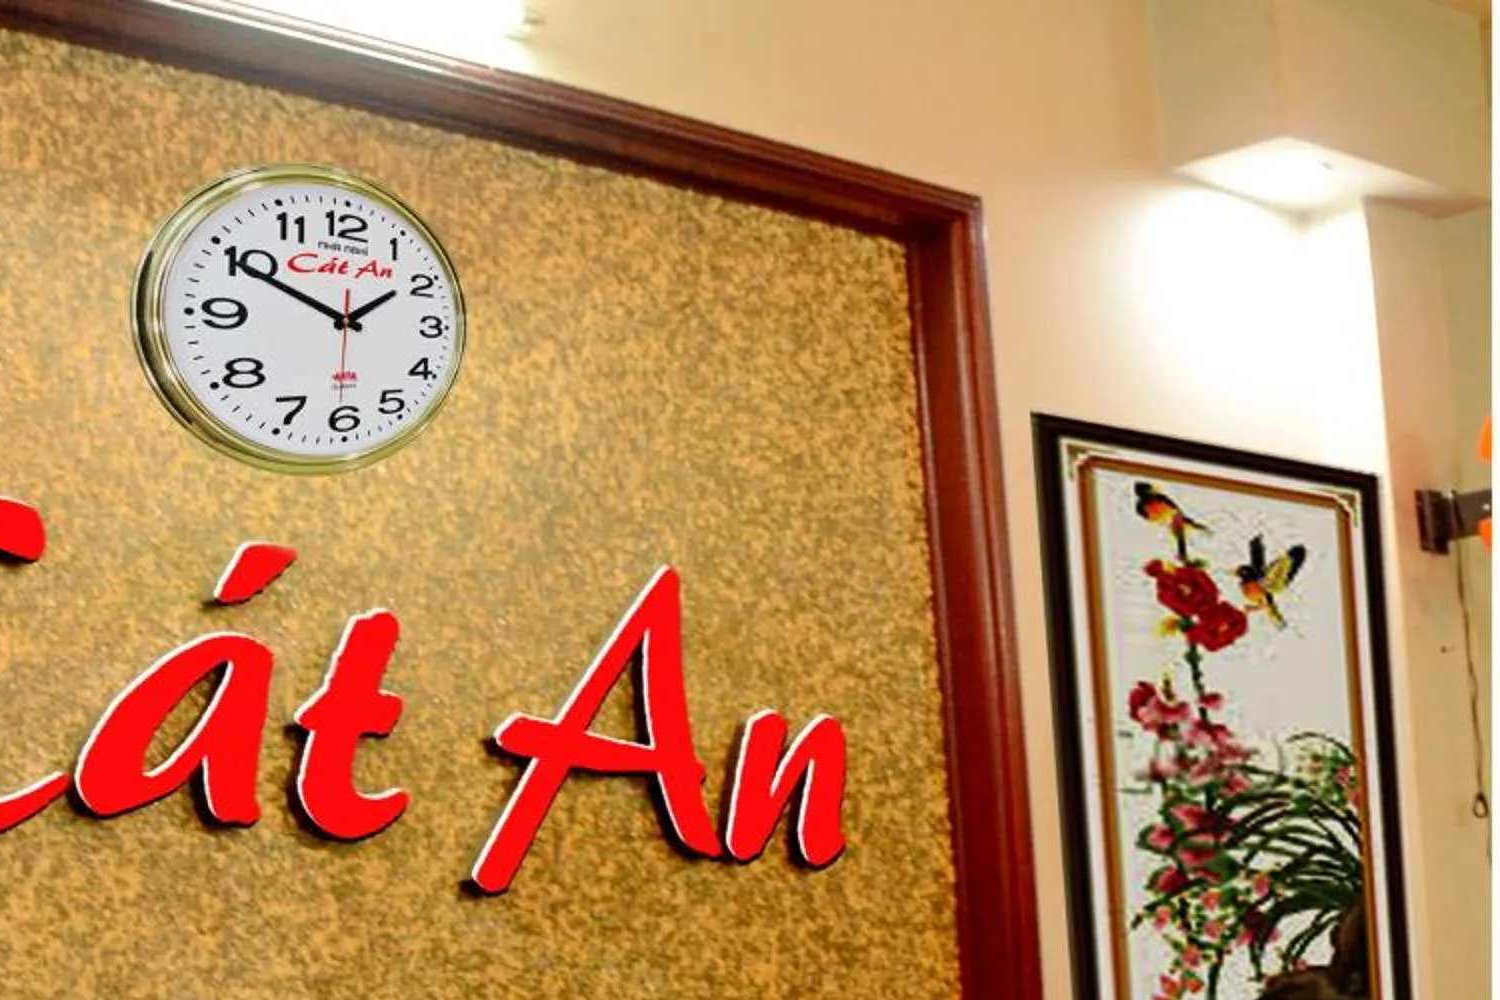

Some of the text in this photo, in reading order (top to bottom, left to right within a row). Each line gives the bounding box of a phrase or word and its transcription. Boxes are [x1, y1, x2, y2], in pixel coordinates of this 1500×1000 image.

[276, 211, 305, 244] 11
[325, 209, 369, 243] 12
[224, 245, 278, 278] 10
[389, 237, 398, 261] 1
[287, 252, 393, 279] Cát An
[409, 273, 435, 298] 2
[200, 297, 249, 330] 9
[419, 315, 444, 339] 3
[222, 357, 266, 389] 8
[408, 357, 433, 381] 4
[275, 395, 308, 426] 7
[378, 389, 405, 415] 5
[328, 405, 361, 433] 6
[462, 564, 848, 896] An
